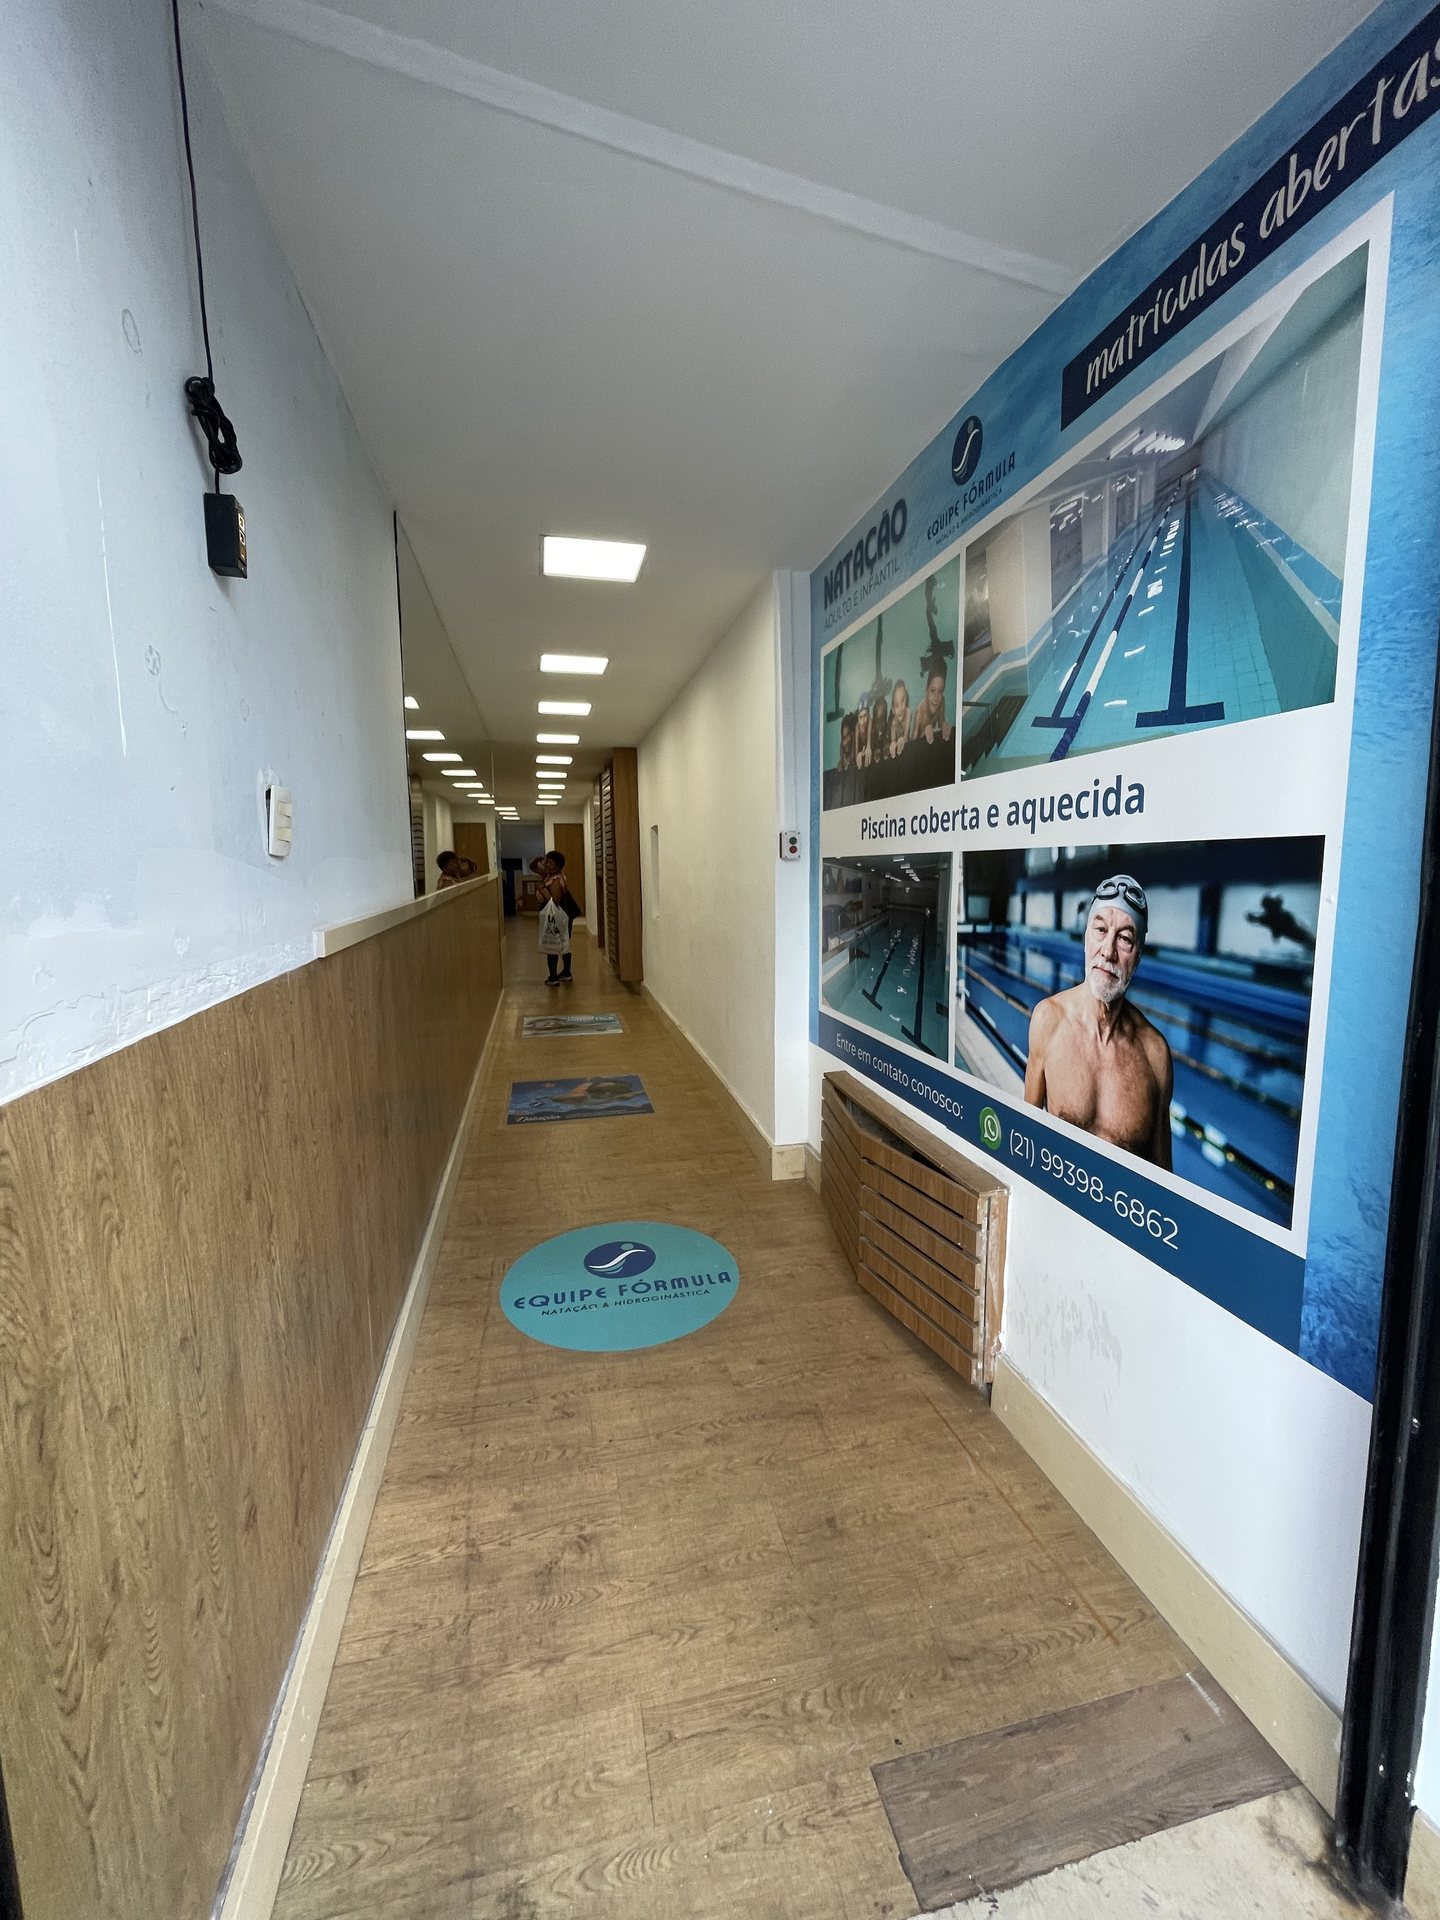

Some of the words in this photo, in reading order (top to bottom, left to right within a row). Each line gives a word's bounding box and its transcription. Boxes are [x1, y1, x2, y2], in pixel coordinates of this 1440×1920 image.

[1086, 221, 1246, 395] matrículas
[927, 500, 960, 540] EQUIPE
[963, 451, 1016, 511] FÓRMULA
[823, 498, 908, 611] NATAÇÃO
[823, 597, 853, 632] ADULTO
[853, 590, 859, 607] E
[860, 557, 900, 601] INFANTIL
[860, 817, 907, 841] Piscina
[910, 805, 980, 836] coberta
[986, 803, 1000, 828] e
[1006, 774, 1145, 835] aquecida
[836, 1033, 857, 1057] Entre
[857, 1050, 872, 1065] em
[872, 1056, 910, 1088] contato
[910, 1077, 965, 1120] conosco:
[1009, 1128, 1036, 1168] (21)
[1040, 1148, 1180, 1250] 99398-6862
[513, 1287, 608, 1310] EQUIPE
[618, 1271, 732, 1297] FÓRMULA
[541, 1303, 598, 1317] NATAÇÃO
[614, 1288, 711, 1307] HIDROGINÁSTICA
